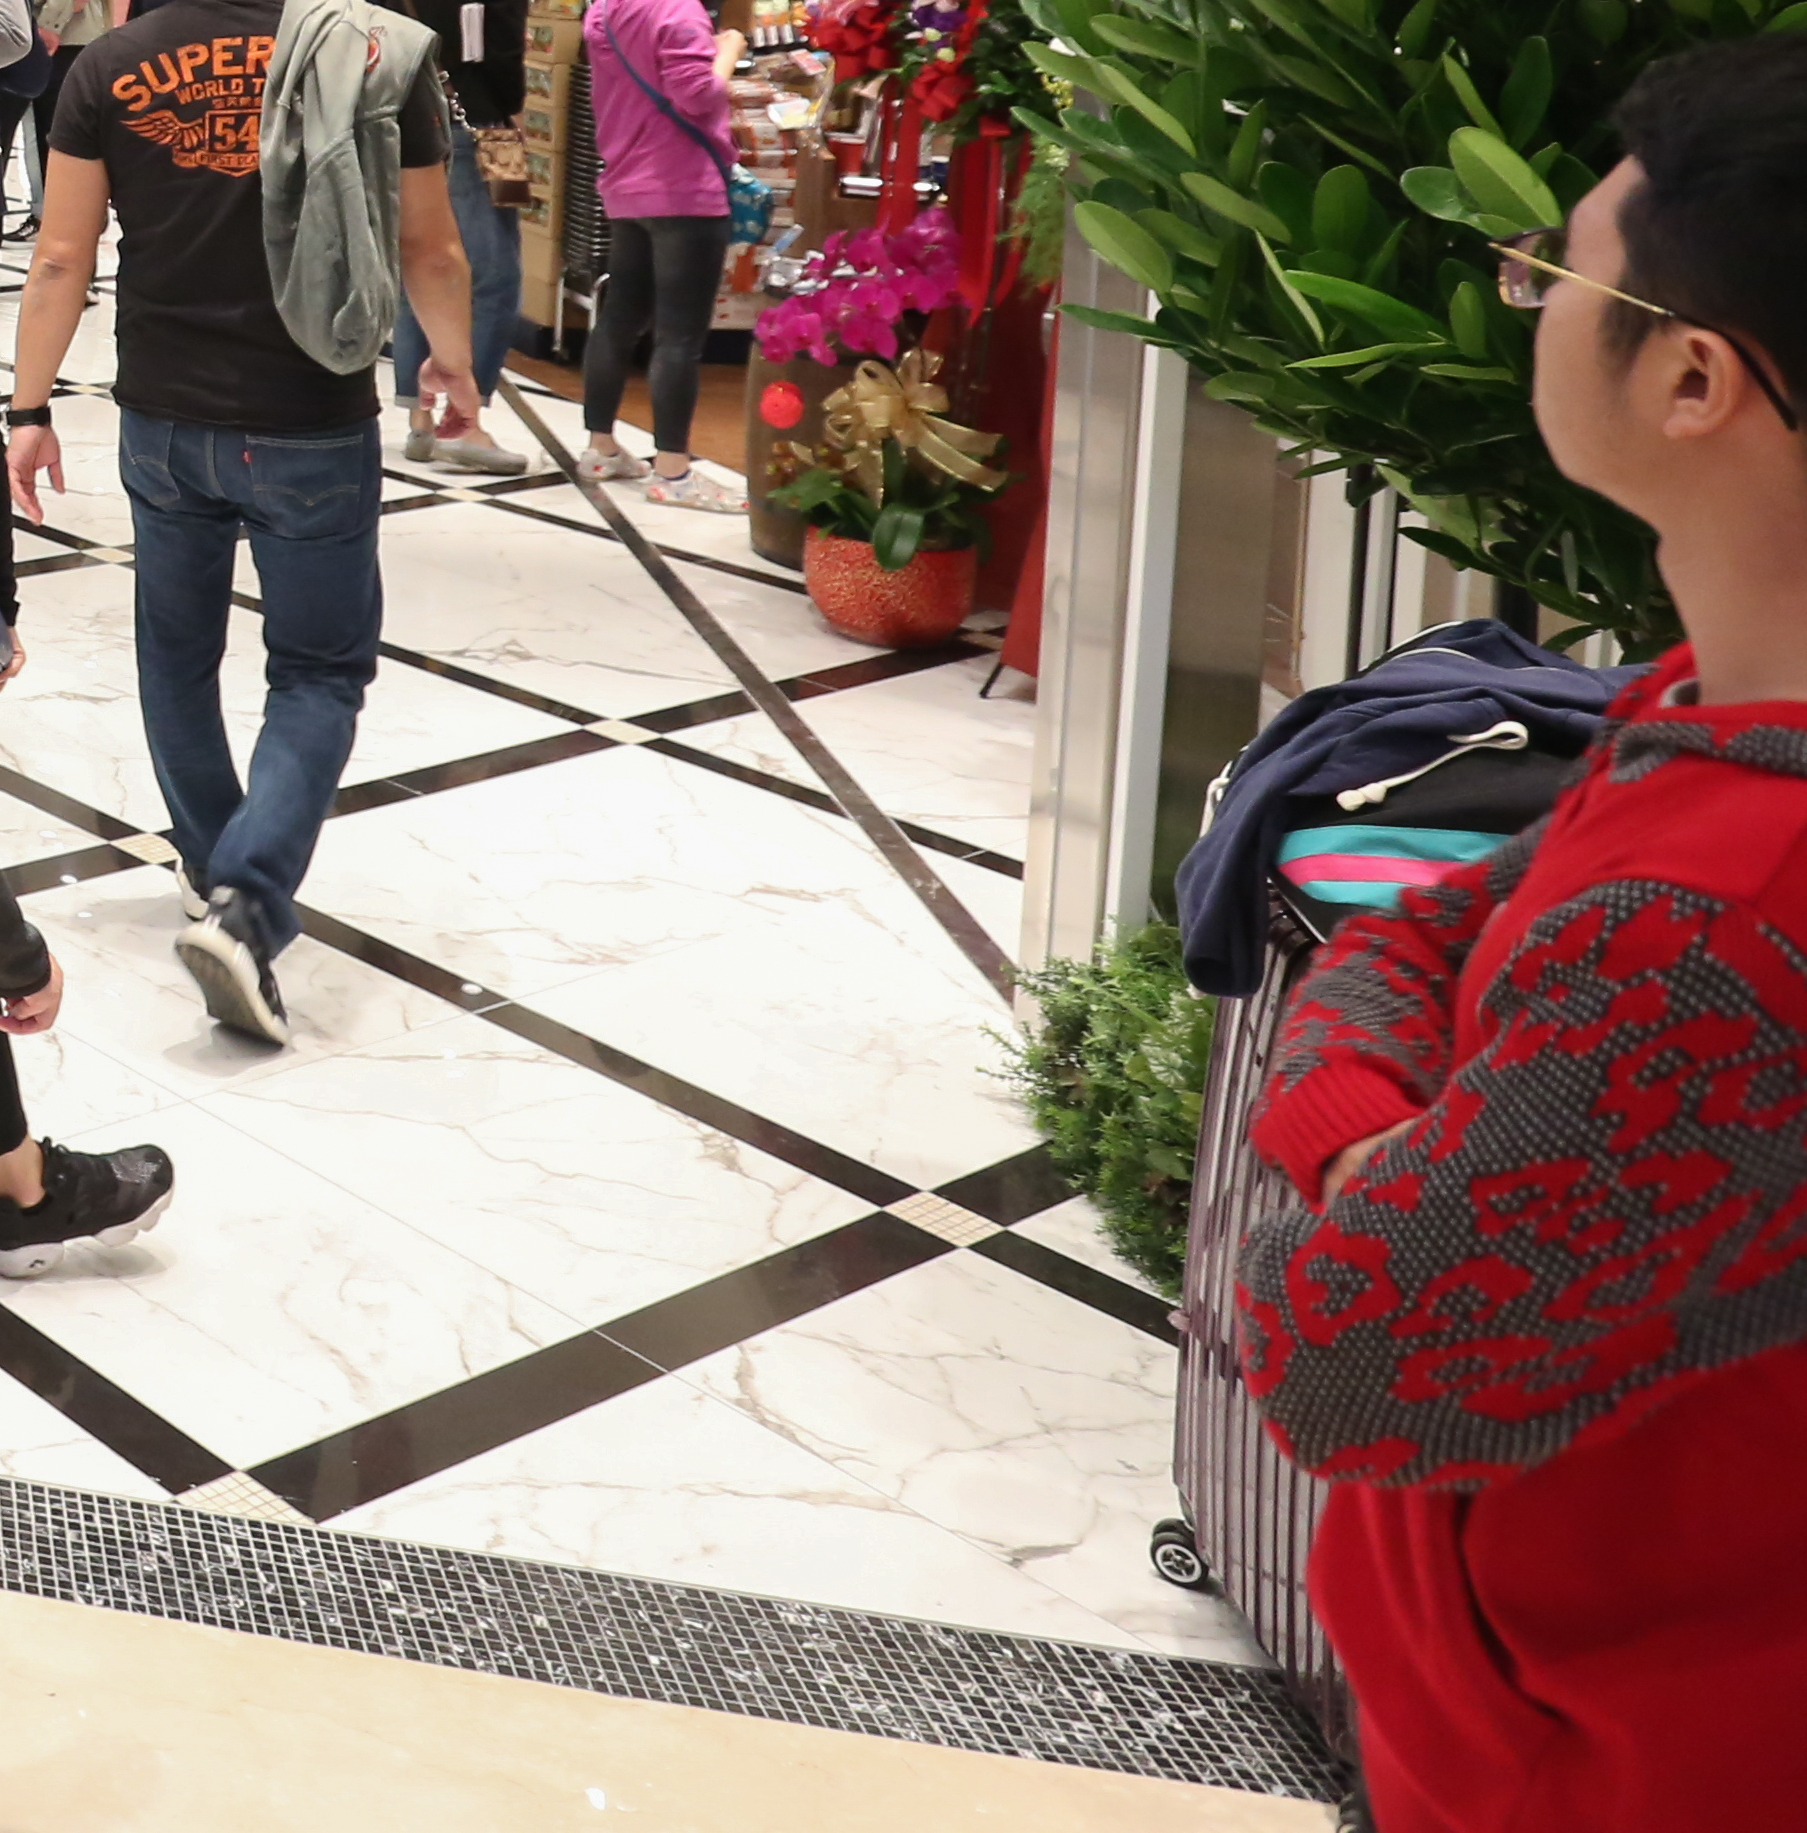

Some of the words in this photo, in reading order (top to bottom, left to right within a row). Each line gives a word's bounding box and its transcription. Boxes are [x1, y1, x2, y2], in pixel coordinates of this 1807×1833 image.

[111, 35, 276, 112] SUPER
[175, 79, 245, 105] WORLD
[214, 115, 261, 152] 54
